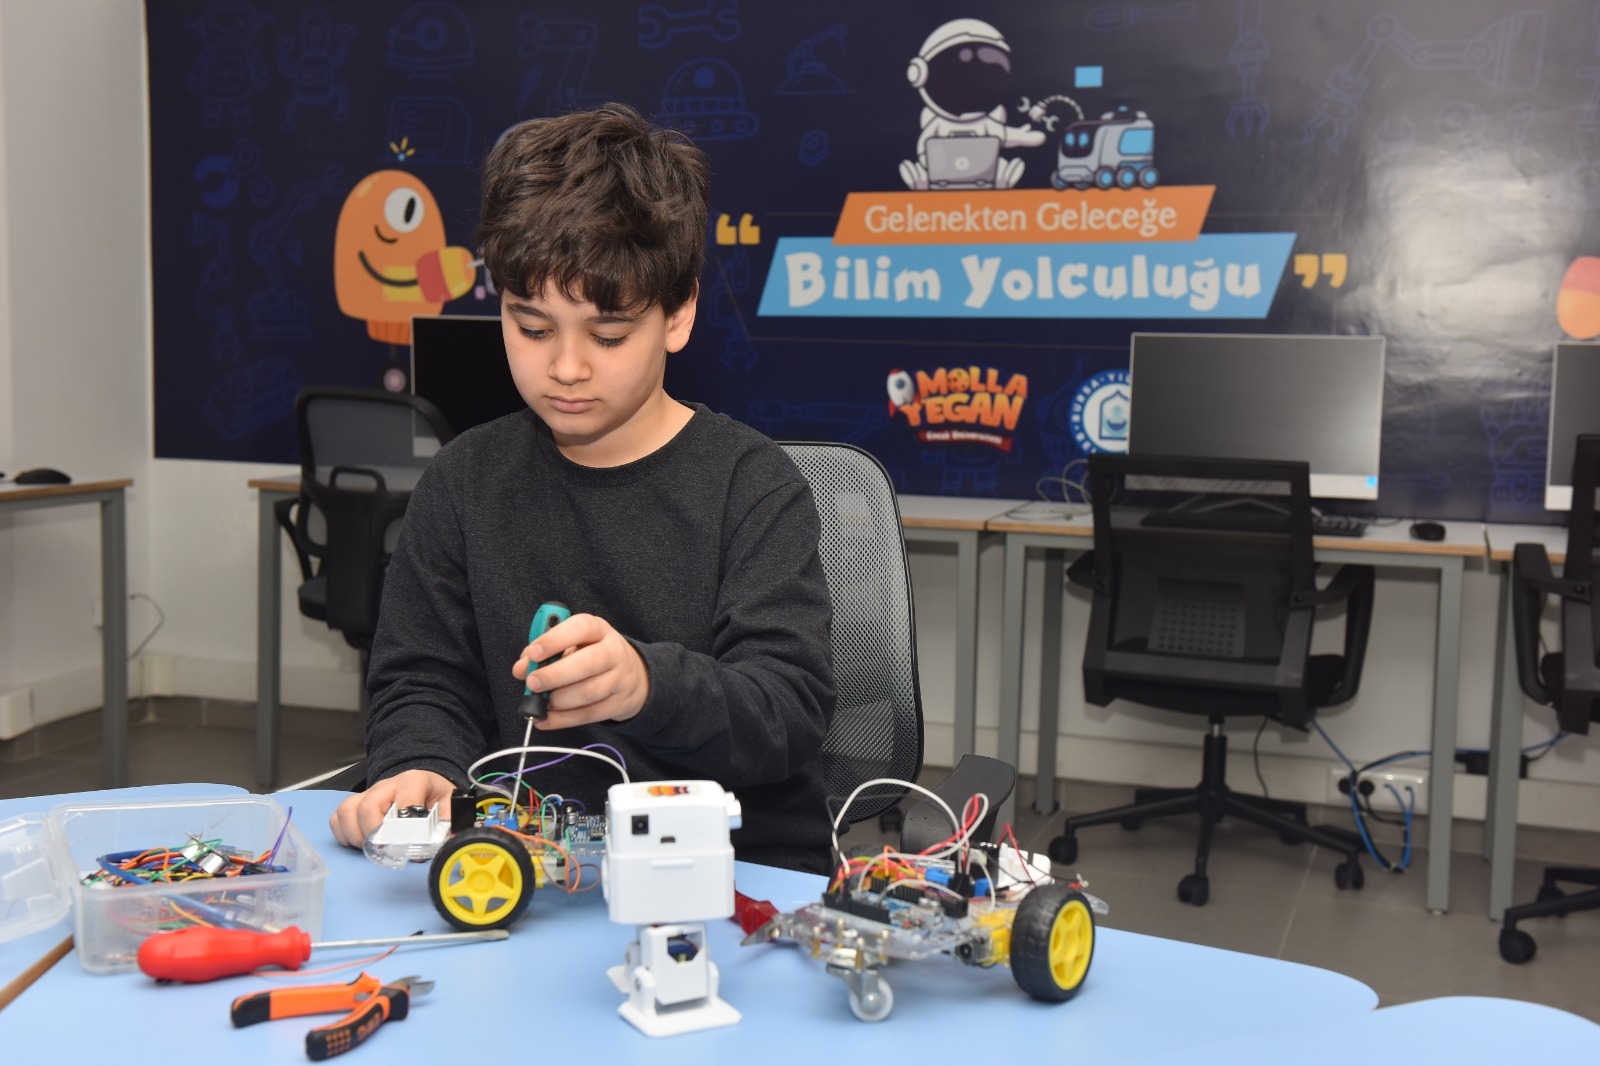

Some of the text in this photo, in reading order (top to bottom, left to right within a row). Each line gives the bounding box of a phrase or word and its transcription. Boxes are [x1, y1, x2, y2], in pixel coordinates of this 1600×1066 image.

[864, 198, 1178, 238] Gelenekten Geleceğe
[784, 252, 1262, 312] Bilim Yolculuğu
[916, 366, 1028, 399] MOLLA
[899, 392, 1026, 431] YEGAN
